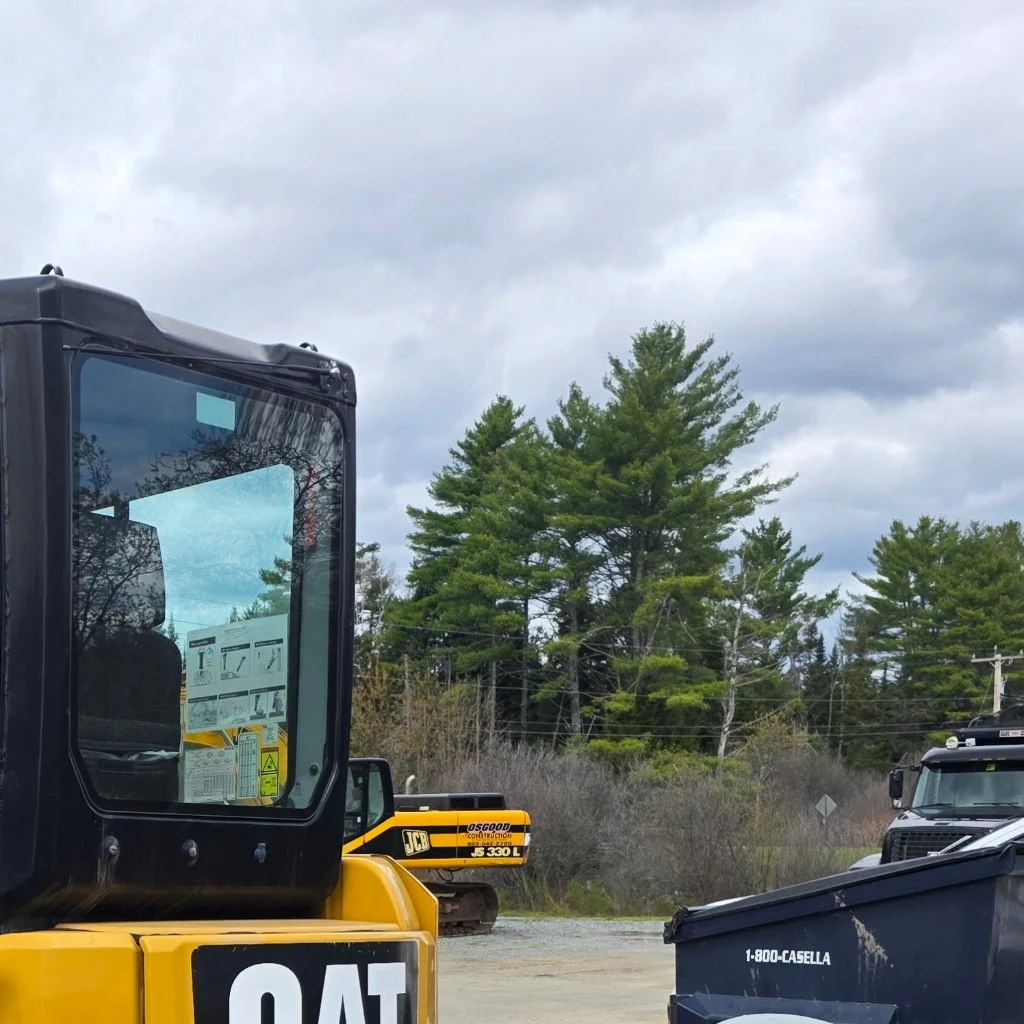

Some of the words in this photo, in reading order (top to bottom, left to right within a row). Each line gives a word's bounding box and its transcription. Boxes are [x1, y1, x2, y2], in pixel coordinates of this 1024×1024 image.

[467, 823, 511, 832] OSGOOD
[404, 831, 429, 854] JCB
[471, 847, 485, 857] JS
[486, 847, 511, 857] 330
[512, 847, 520, 857] L
[745, 948, 831, 965] 1-800-CASELLA
